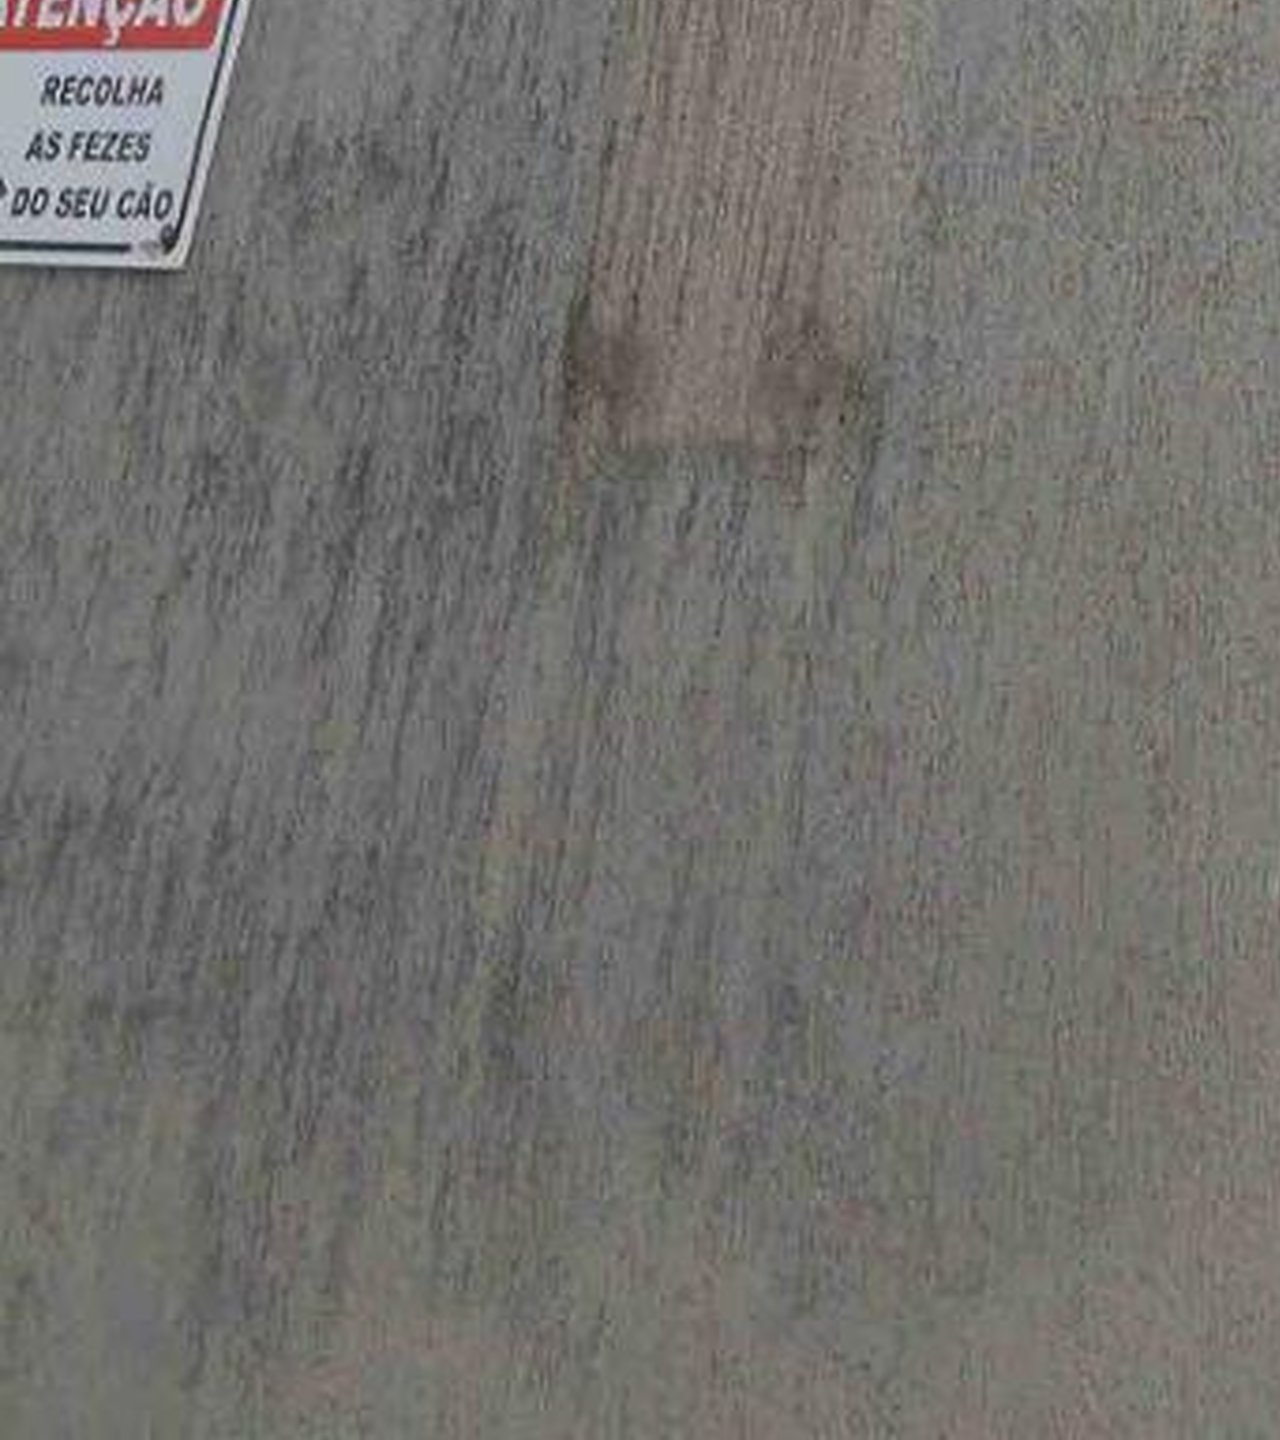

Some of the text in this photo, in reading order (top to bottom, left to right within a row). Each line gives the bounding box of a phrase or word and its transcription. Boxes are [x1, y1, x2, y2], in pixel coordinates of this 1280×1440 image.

[41, 75, 163, 106] RECOLHA
[25, 131, 151, 162] AS FEZES
[11, 180, 174, 220] DO SEU CÃO
